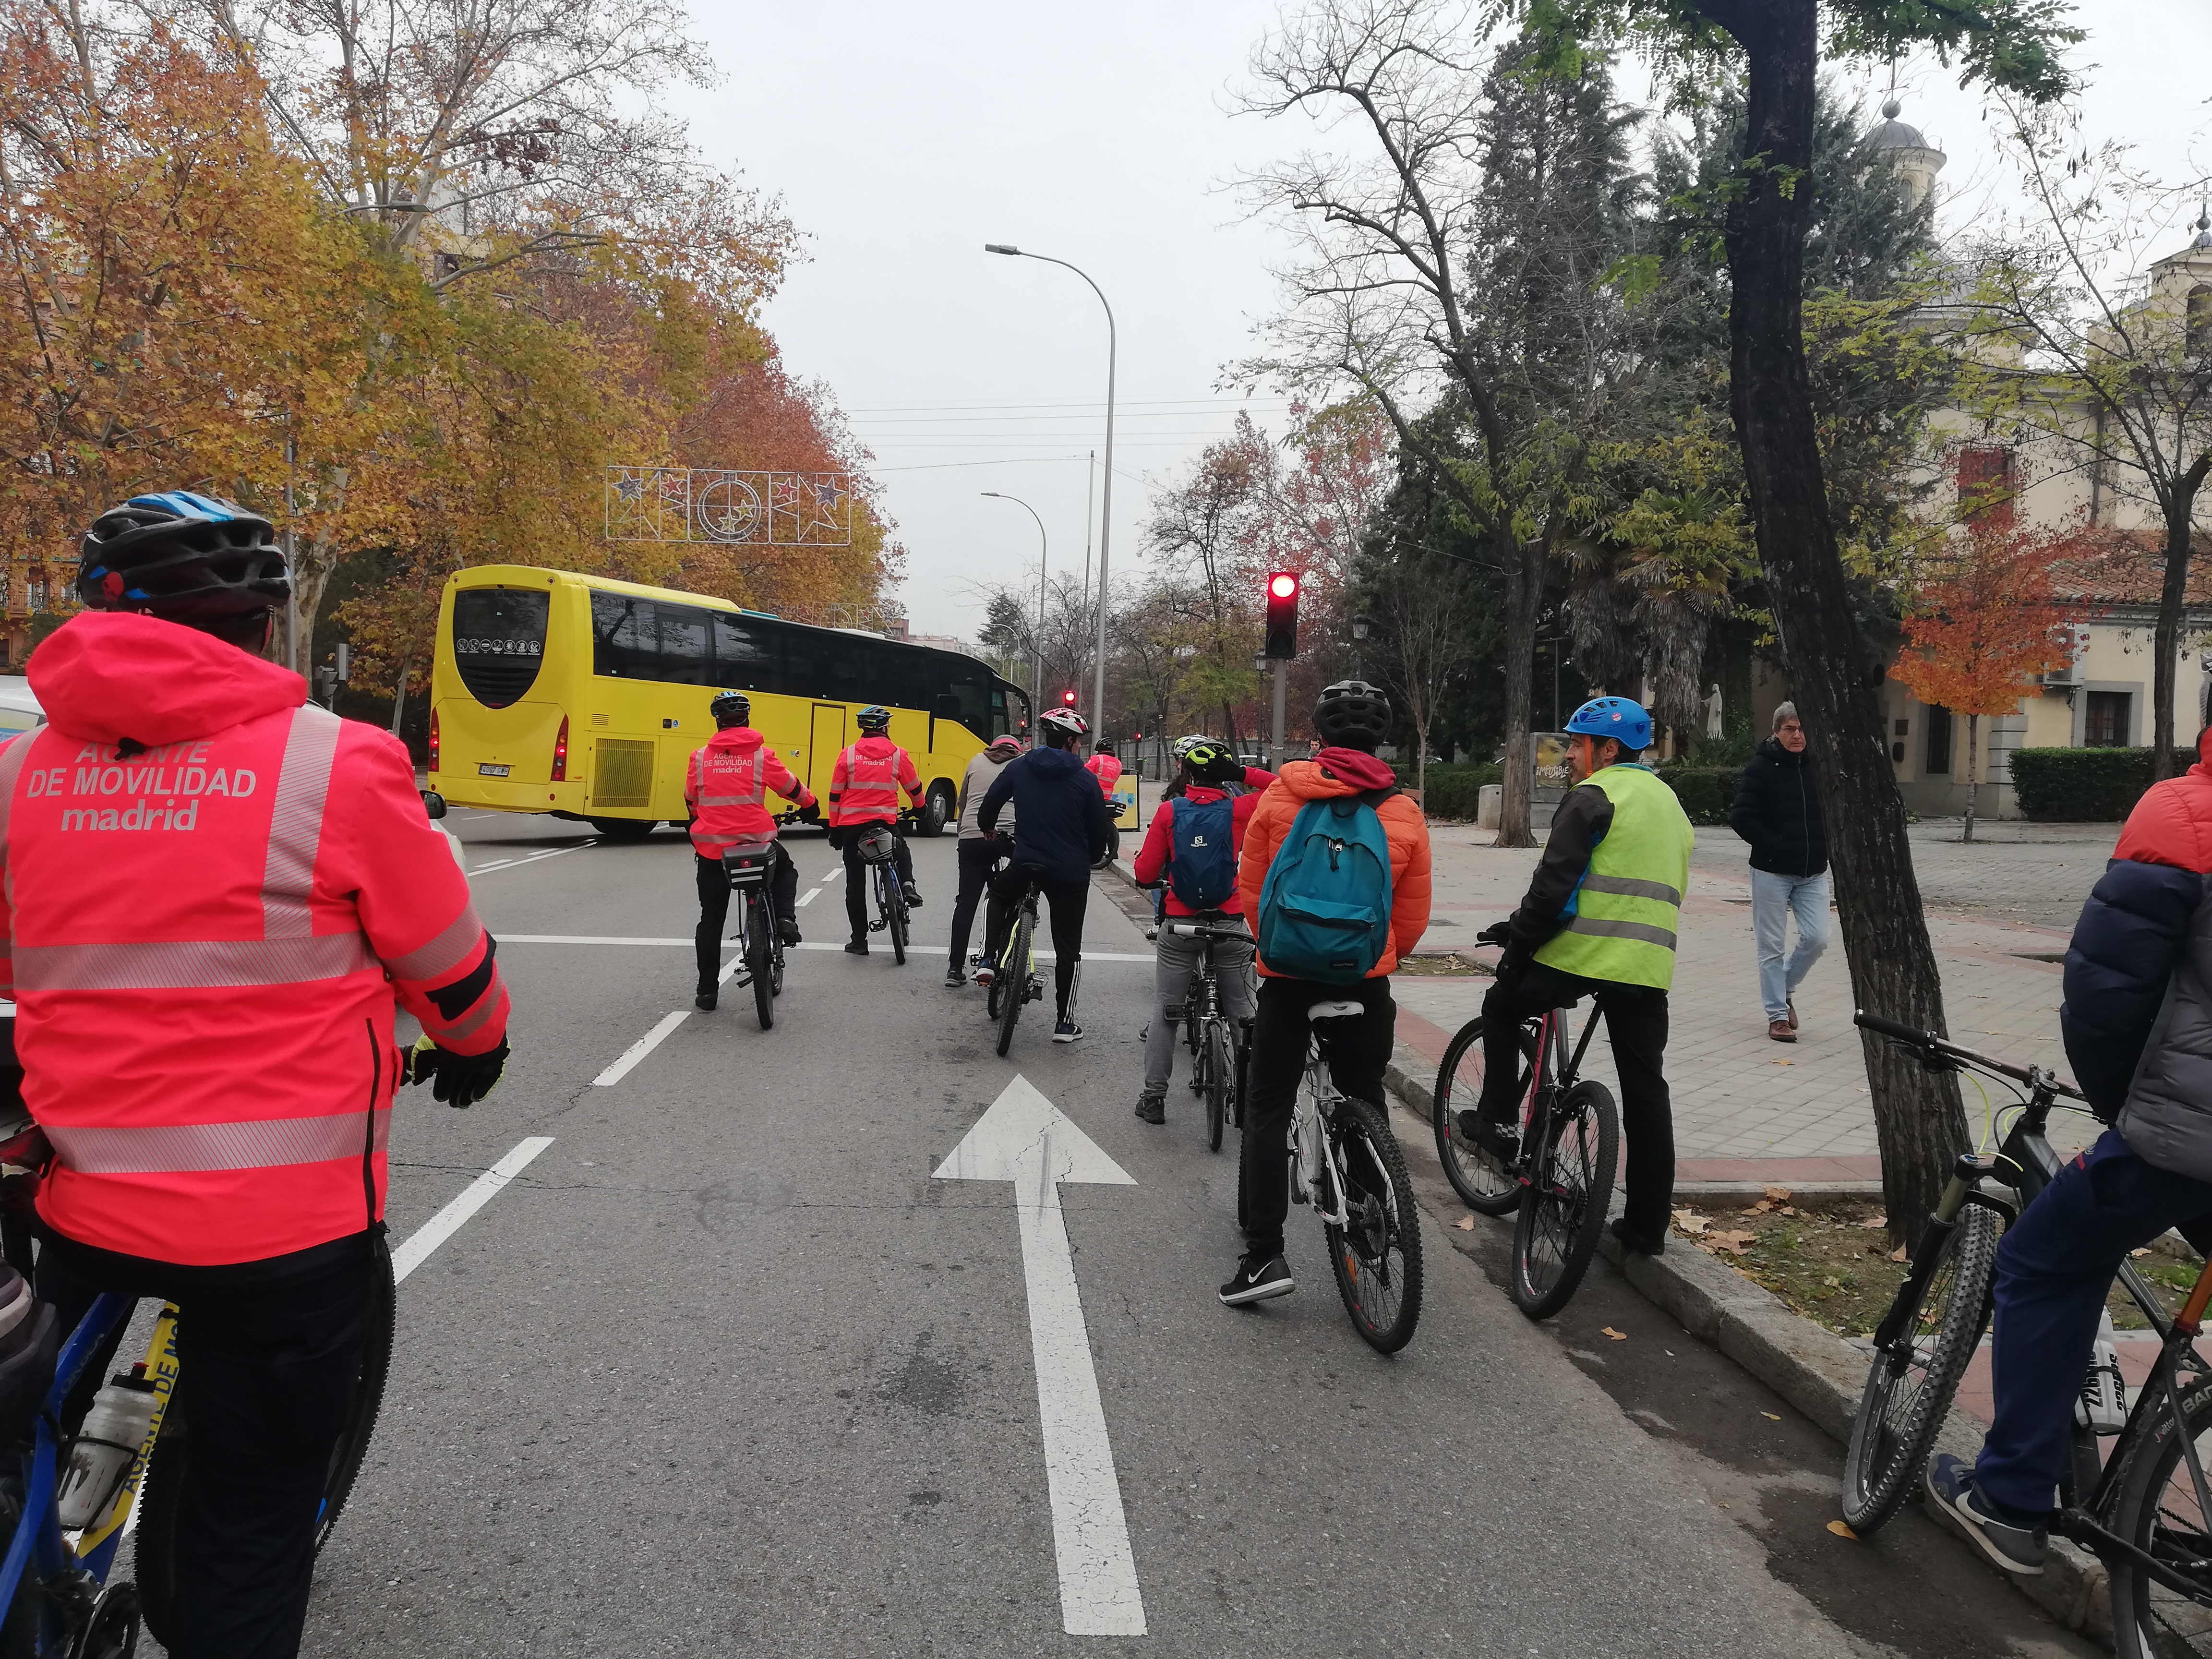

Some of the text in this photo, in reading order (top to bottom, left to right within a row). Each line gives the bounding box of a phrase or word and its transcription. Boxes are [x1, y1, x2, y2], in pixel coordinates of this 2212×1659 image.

[26, 767, 256, 798] DE MOVILIDAD
[61, 799, 199, 831] madrid
[155, 1361, 178, 1395] DE
